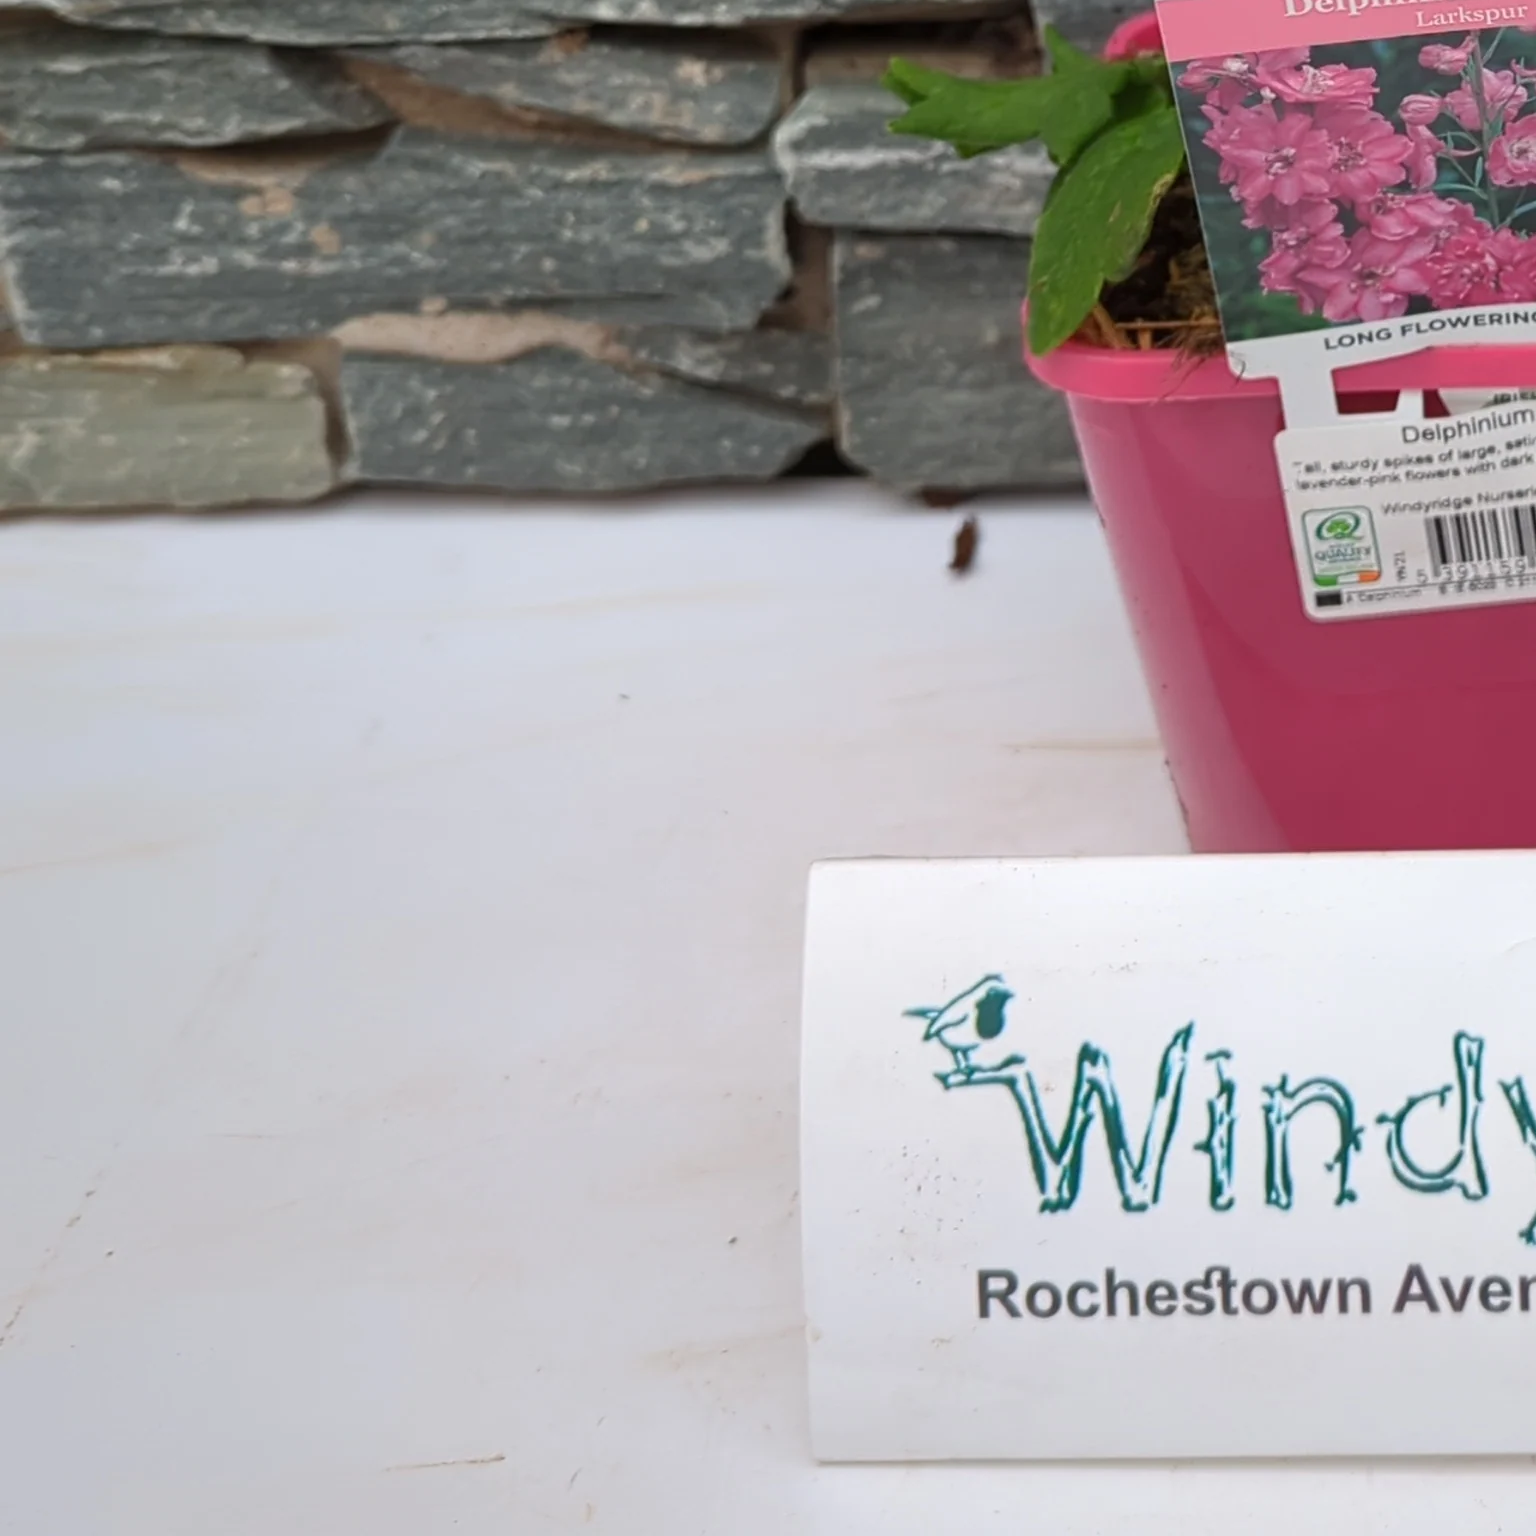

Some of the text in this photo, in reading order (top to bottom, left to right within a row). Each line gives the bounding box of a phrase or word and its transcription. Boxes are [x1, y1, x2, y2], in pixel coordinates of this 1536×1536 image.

[1416, 4, 1528, 28] Larkspur
[1324, 327, 1392, 351] LONG
[1402, 408, 1535, 444] Delphinium
[1331, 457, 1379, 472] sturdy
[1384, 454, 1434, 469] spikes
[1438, 450, 1455, 463] of
[1405, 466, 1461, 482] flowers
[1464, 461, 1497, 476] with
[1501, 451, 1533, 469] dark
[1382, 495, 1473, 514] Windyridge
[977, 1265, 1371, 1321] Rochestown
